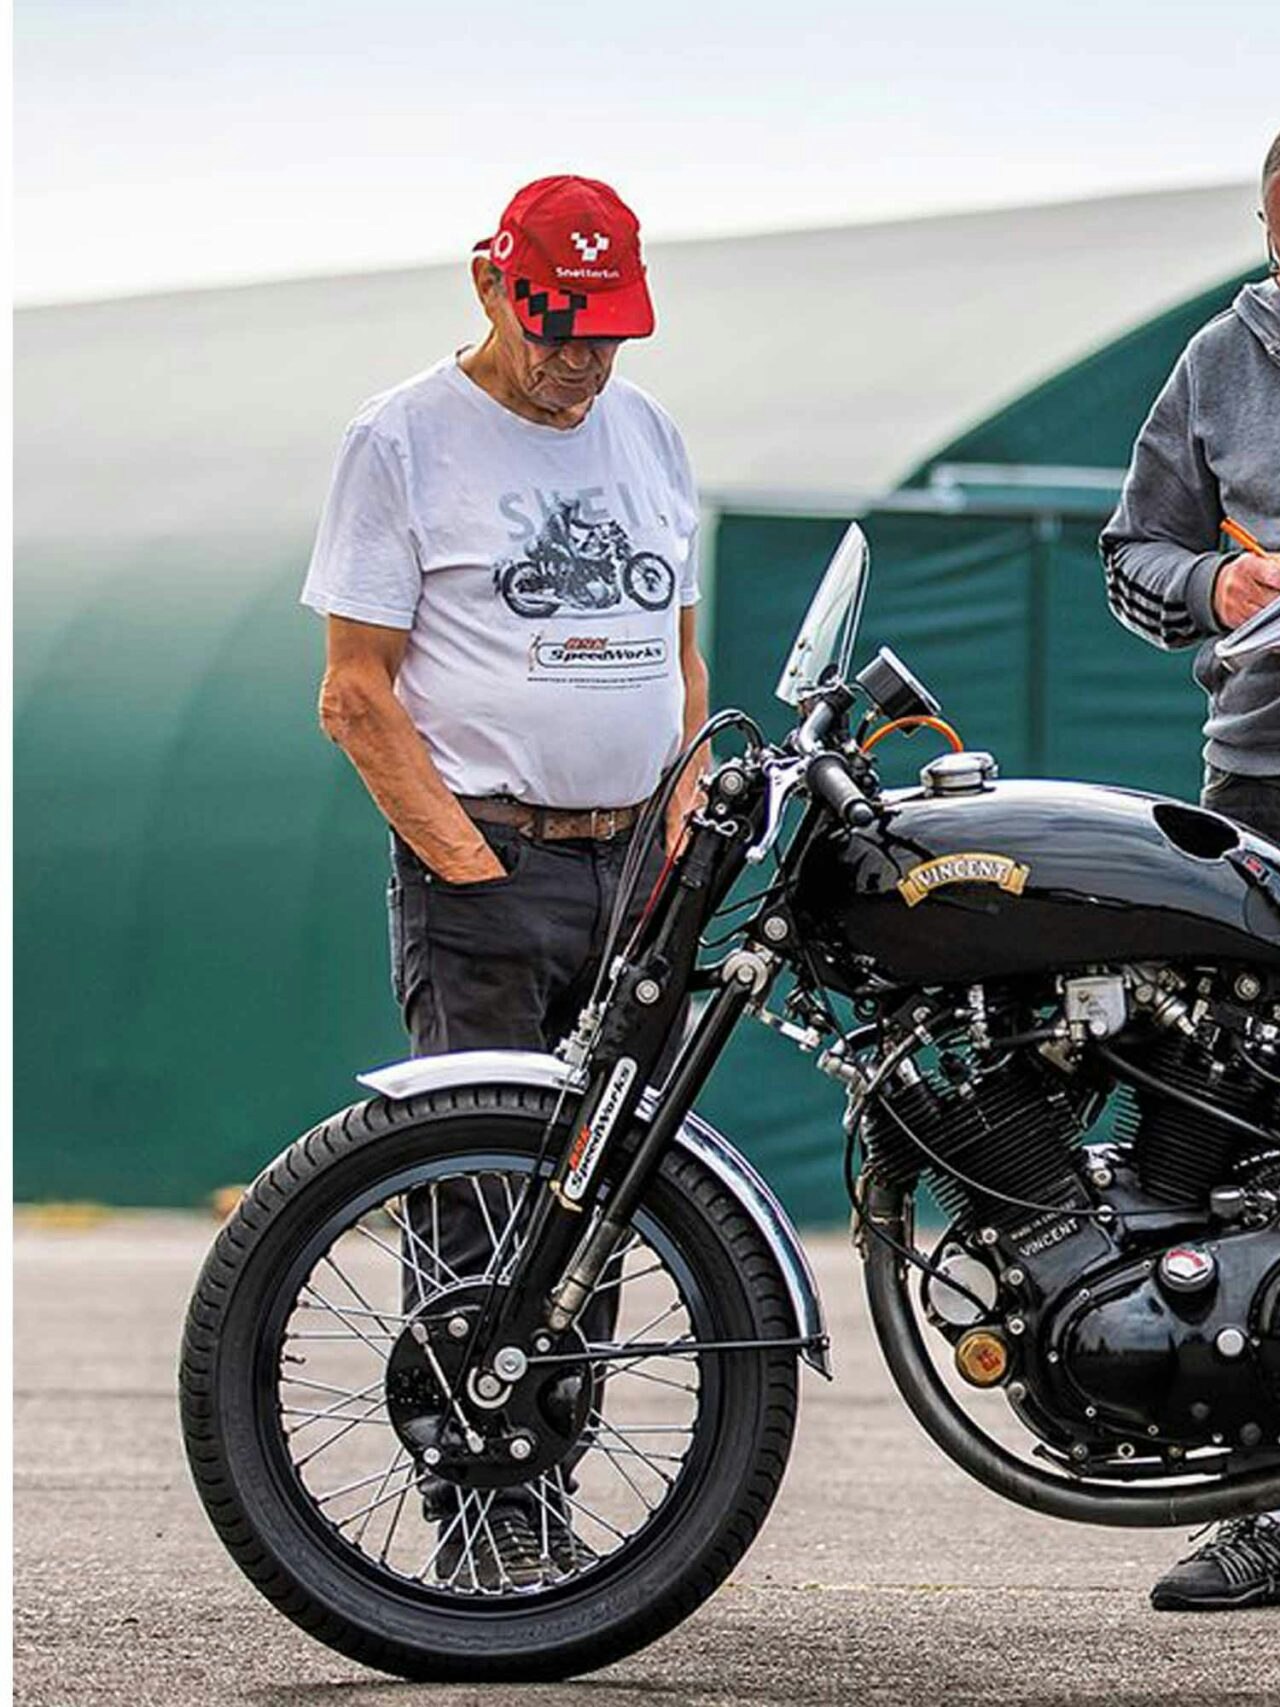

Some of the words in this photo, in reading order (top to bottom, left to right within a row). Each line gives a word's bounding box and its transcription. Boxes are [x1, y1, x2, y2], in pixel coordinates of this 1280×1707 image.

[549, 646, 662, 663] SpeedWorks
[917, 859, 1008, 887] VINCENT
[571, 1066, 630, 1191] SpeedWorks
[1018, 1216, 1079, 1257] VINCENT
